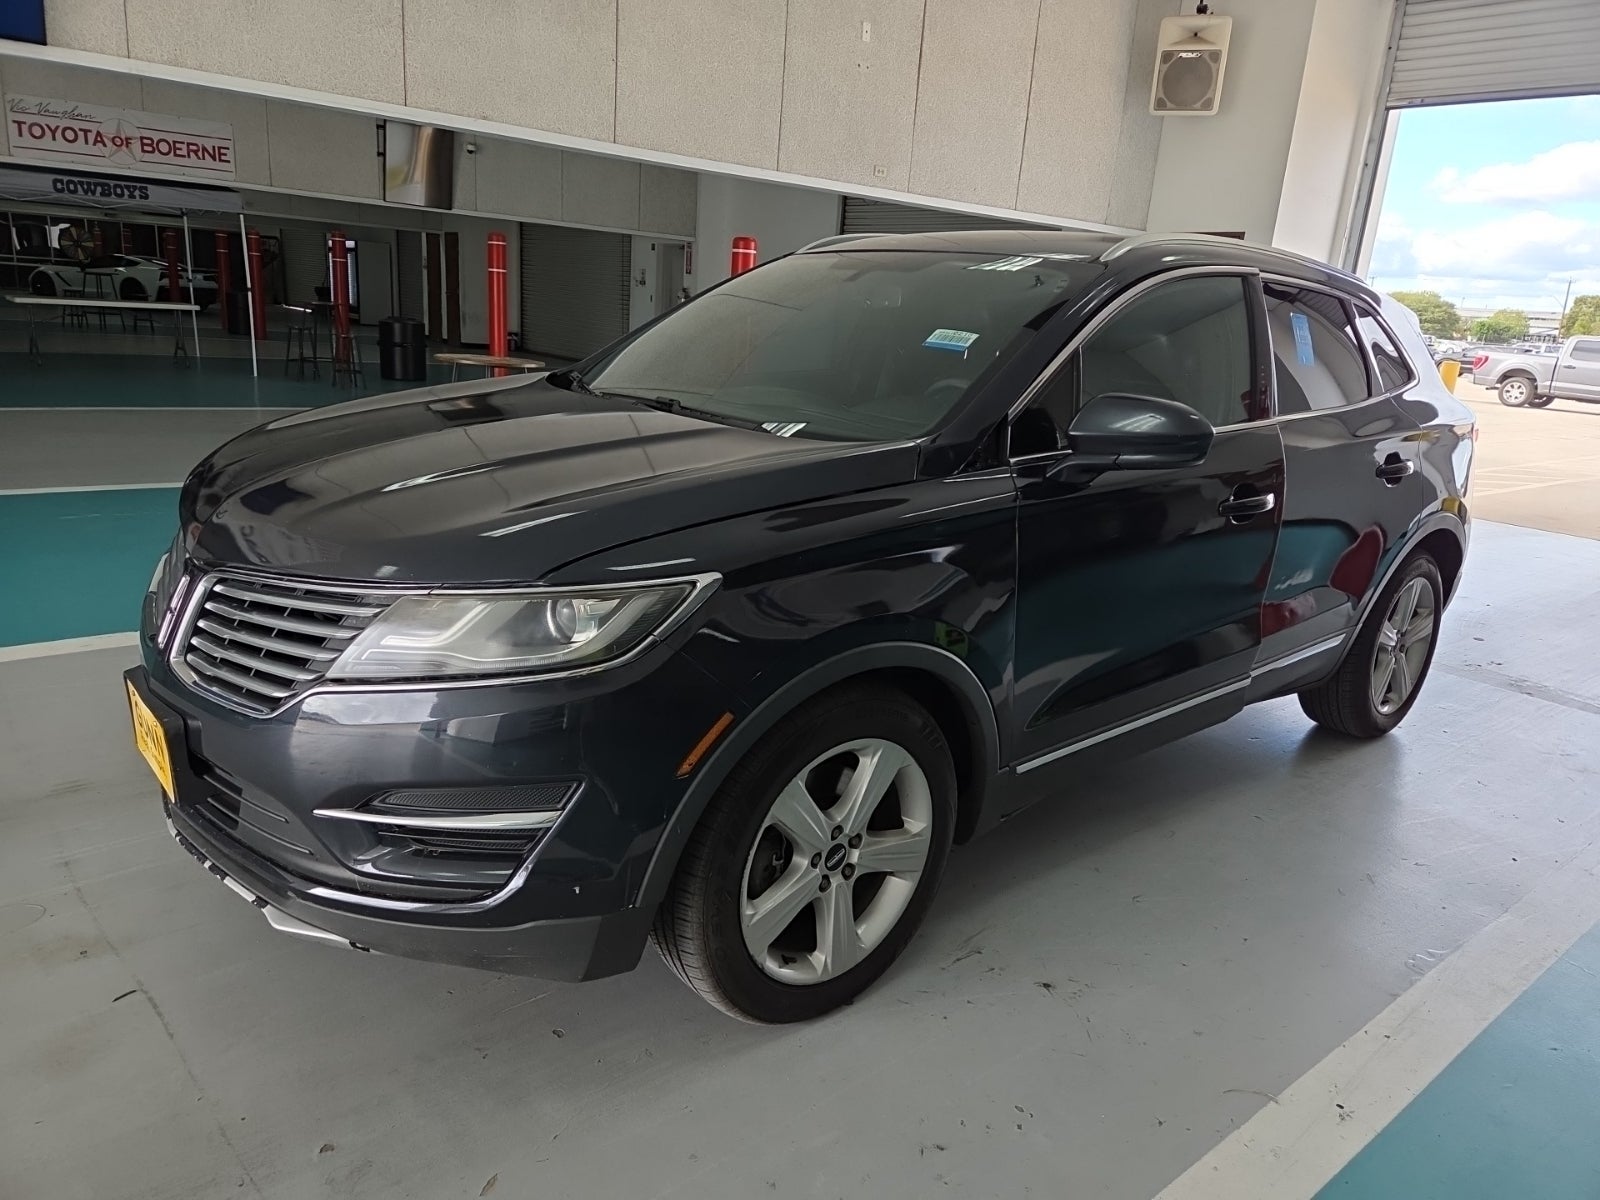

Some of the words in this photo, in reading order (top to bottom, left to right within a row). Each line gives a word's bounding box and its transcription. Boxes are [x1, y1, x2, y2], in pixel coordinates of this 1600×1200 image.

[34, 102, 97, 120] Vaughan
[12, 119, 107, 148] TOYOTA
[111, 136, 132, 149] OF
[140, 135, 231, 163] BOERNE
[52, 178, 149, 200] COWBOYS
